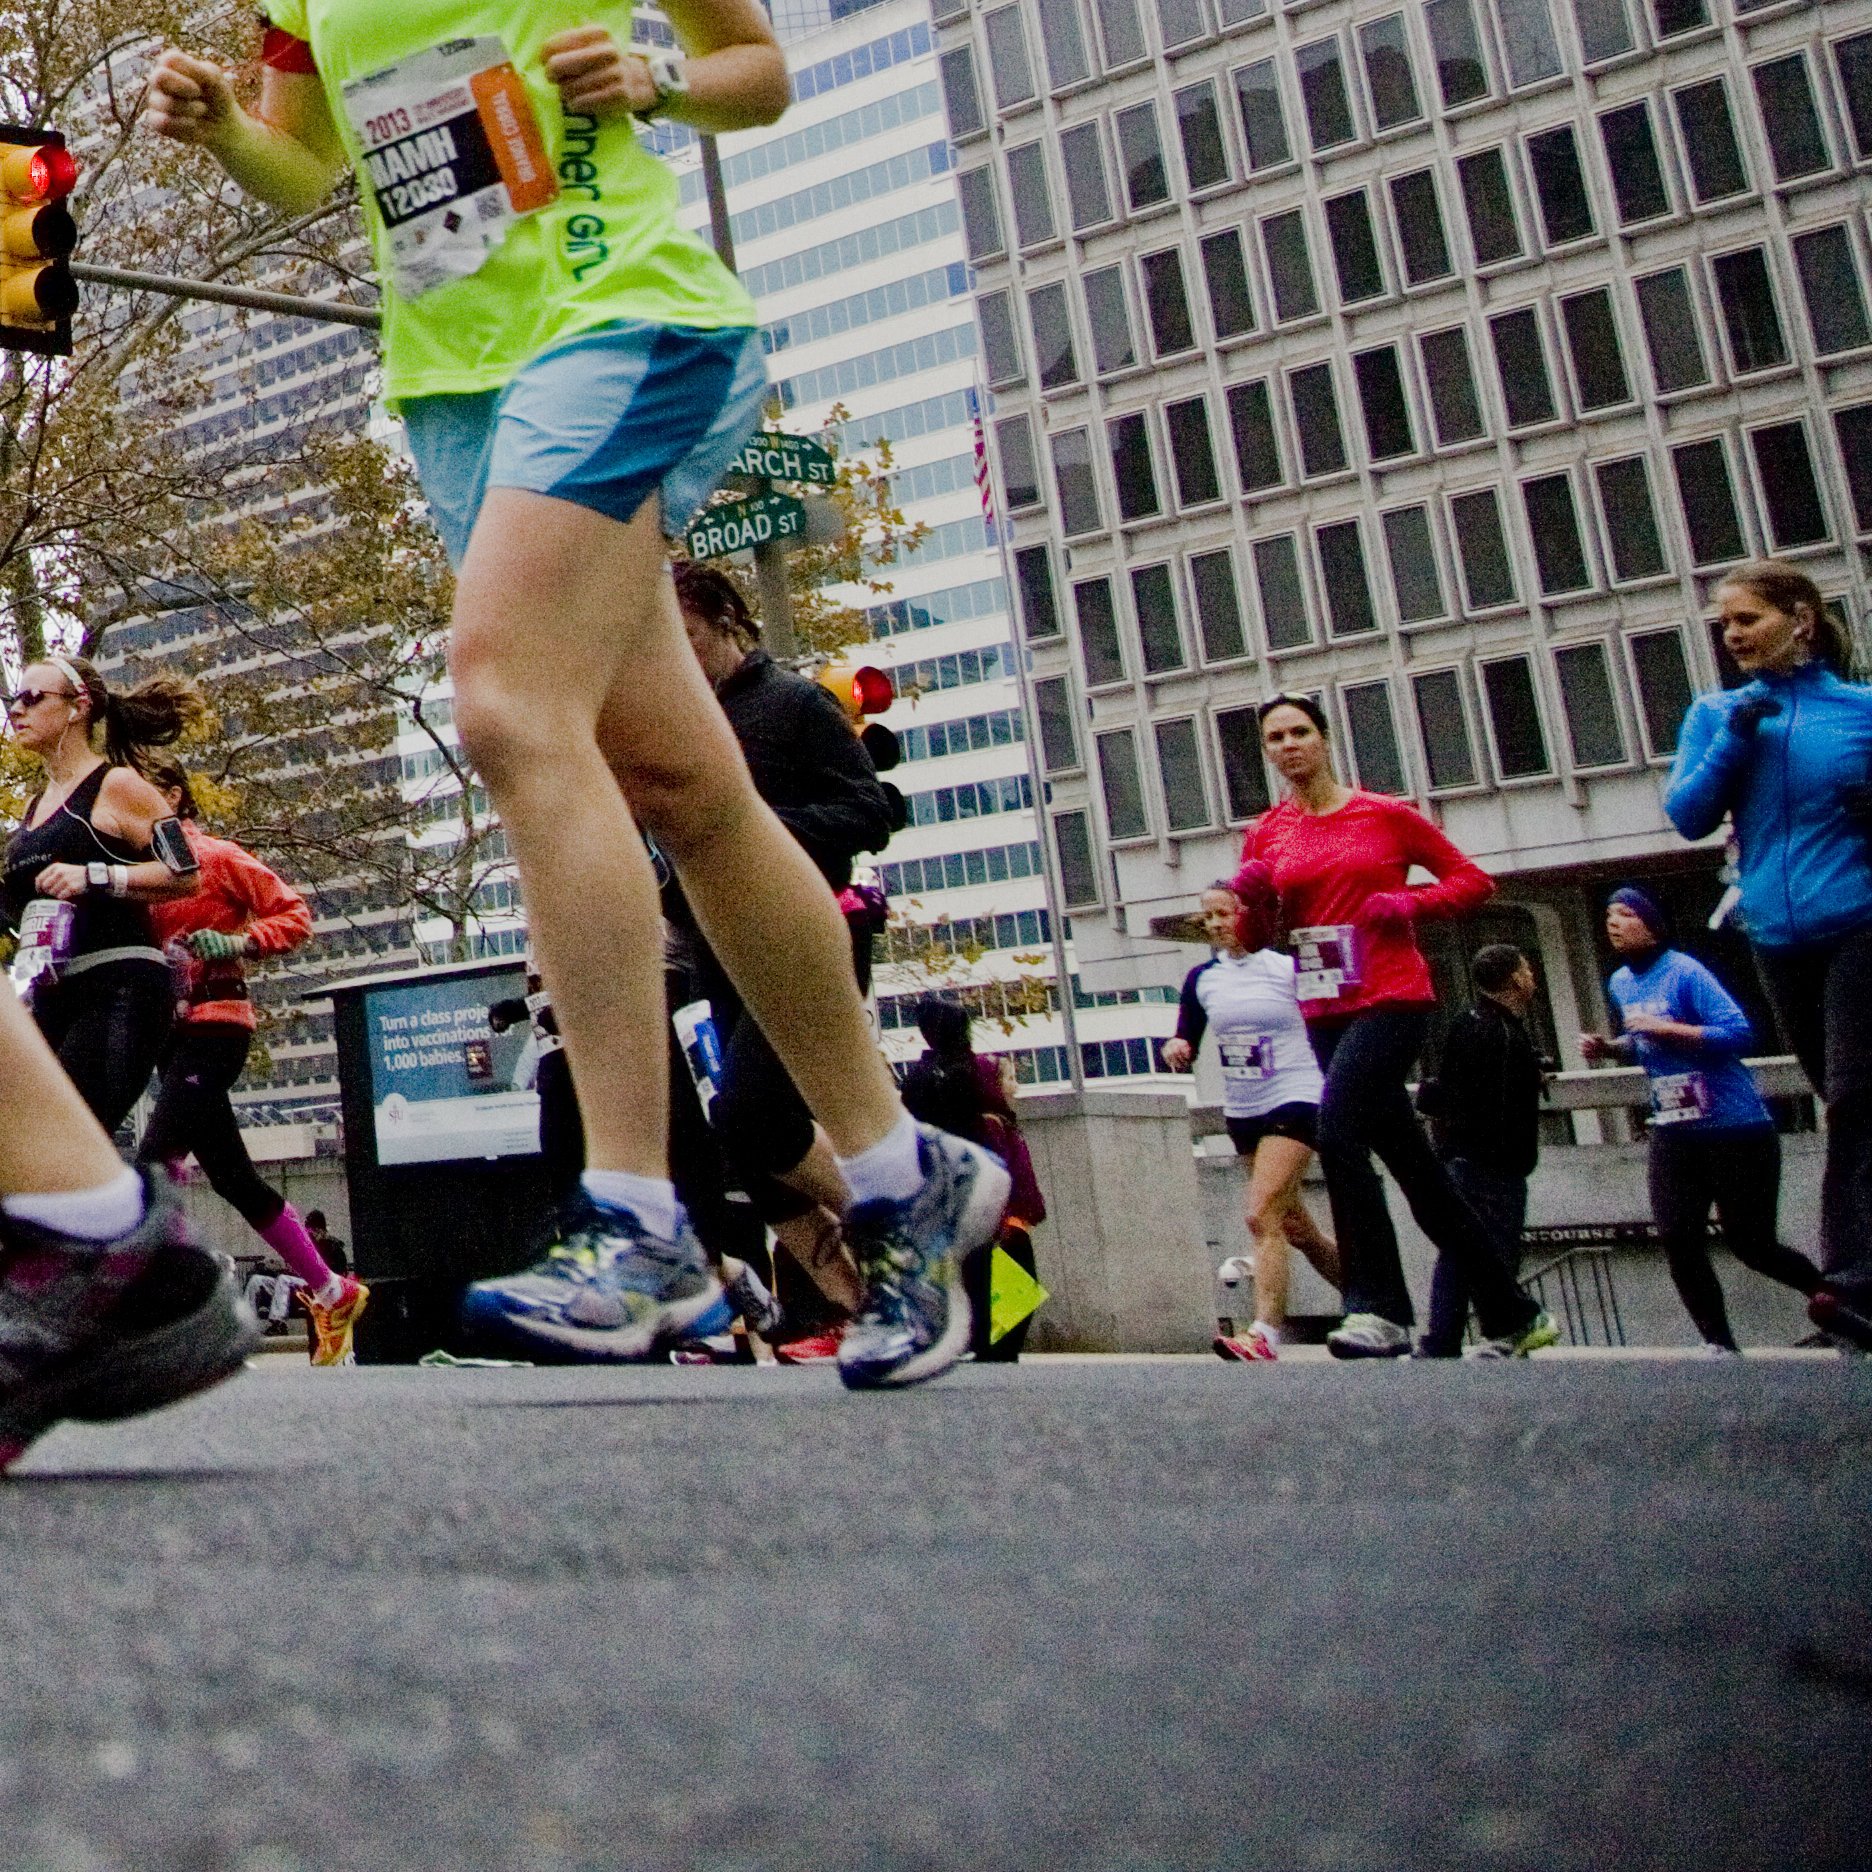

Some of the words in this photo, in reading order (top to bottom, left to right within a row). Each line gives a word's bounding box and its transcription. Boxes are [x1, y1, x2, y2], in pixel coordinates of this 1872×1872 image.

[365, 108, 411, 144] 2013
[727, 448, 802, 478] ARCH
[808, 463, 829, 481] ST
[692, 514, 772, 559] BROAD
[778, 512, 798, 534] ST
[379, 1015, 408, 1031] Turn
[409, 1015, 418, 1028] a
[420, 1009, 451, 1026] class
[454, 1003, 489, 1024] proje
[383, 1035, 410, 1050] into
[411, 1024, 491, 1048] vaccinations
[384, 1053, 418, 1072] 1,000
[419, 1048, 466, 1067] babies.
